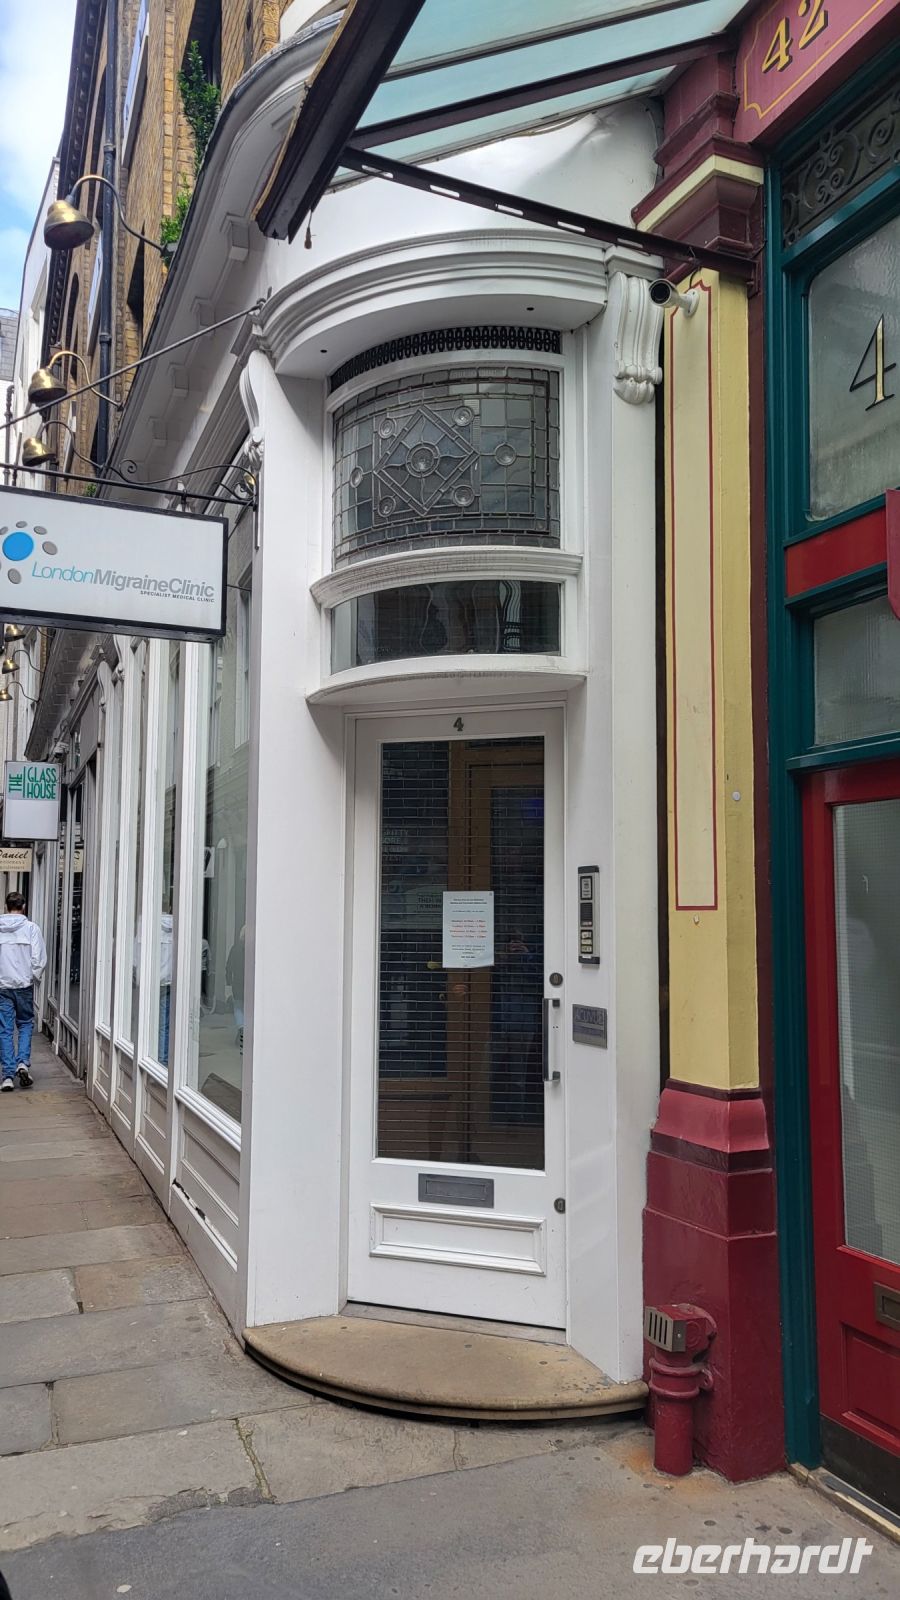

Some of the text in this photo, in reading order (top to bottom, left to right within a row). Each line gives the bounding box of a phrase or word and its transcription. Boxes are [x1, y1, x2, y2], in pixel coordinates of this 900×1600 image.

[761, 0, 828, 73] 42
[849, 313, 896, 411] 4
[32, 561, 215, 597] LondonMigraineClinic
[140, 590, 171, 598] SPECIALIST
[453, 717, 464, 731] 4
[9, 773, 22, 792] THE
[27, 767, 57, 783] GLASS
[27, 782, 56, 799] HOUSE
